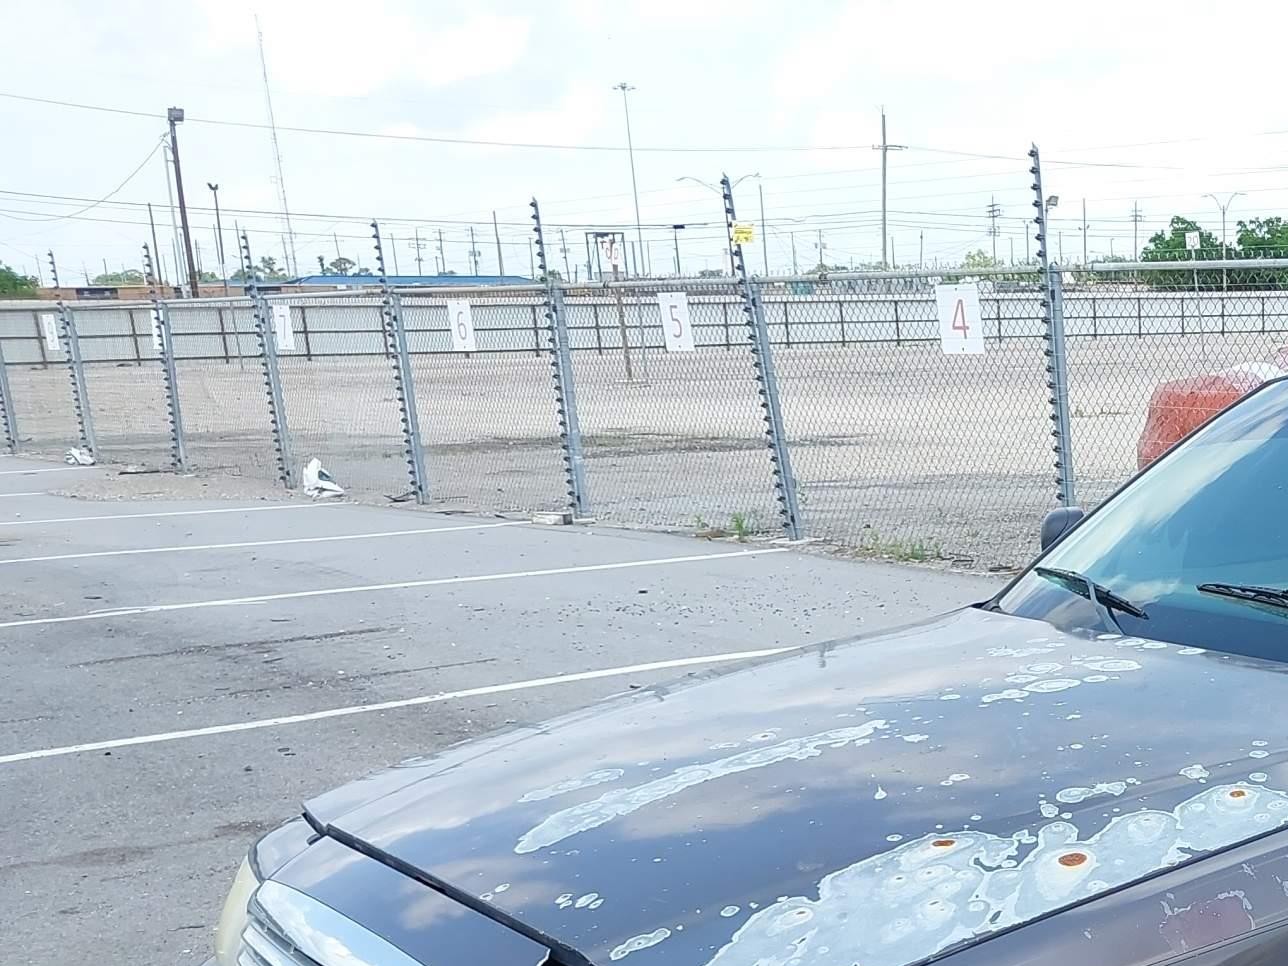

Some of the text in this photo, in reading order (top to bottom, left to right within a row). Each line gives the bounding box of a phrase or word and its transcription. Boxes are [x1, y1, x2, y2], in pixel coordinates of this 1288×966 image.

[279, 314, 287, 341] 7
[456, 311, 467, 340] 6
[669, 305, 683, 338] 5
[951, 298, 970, 339] 4
